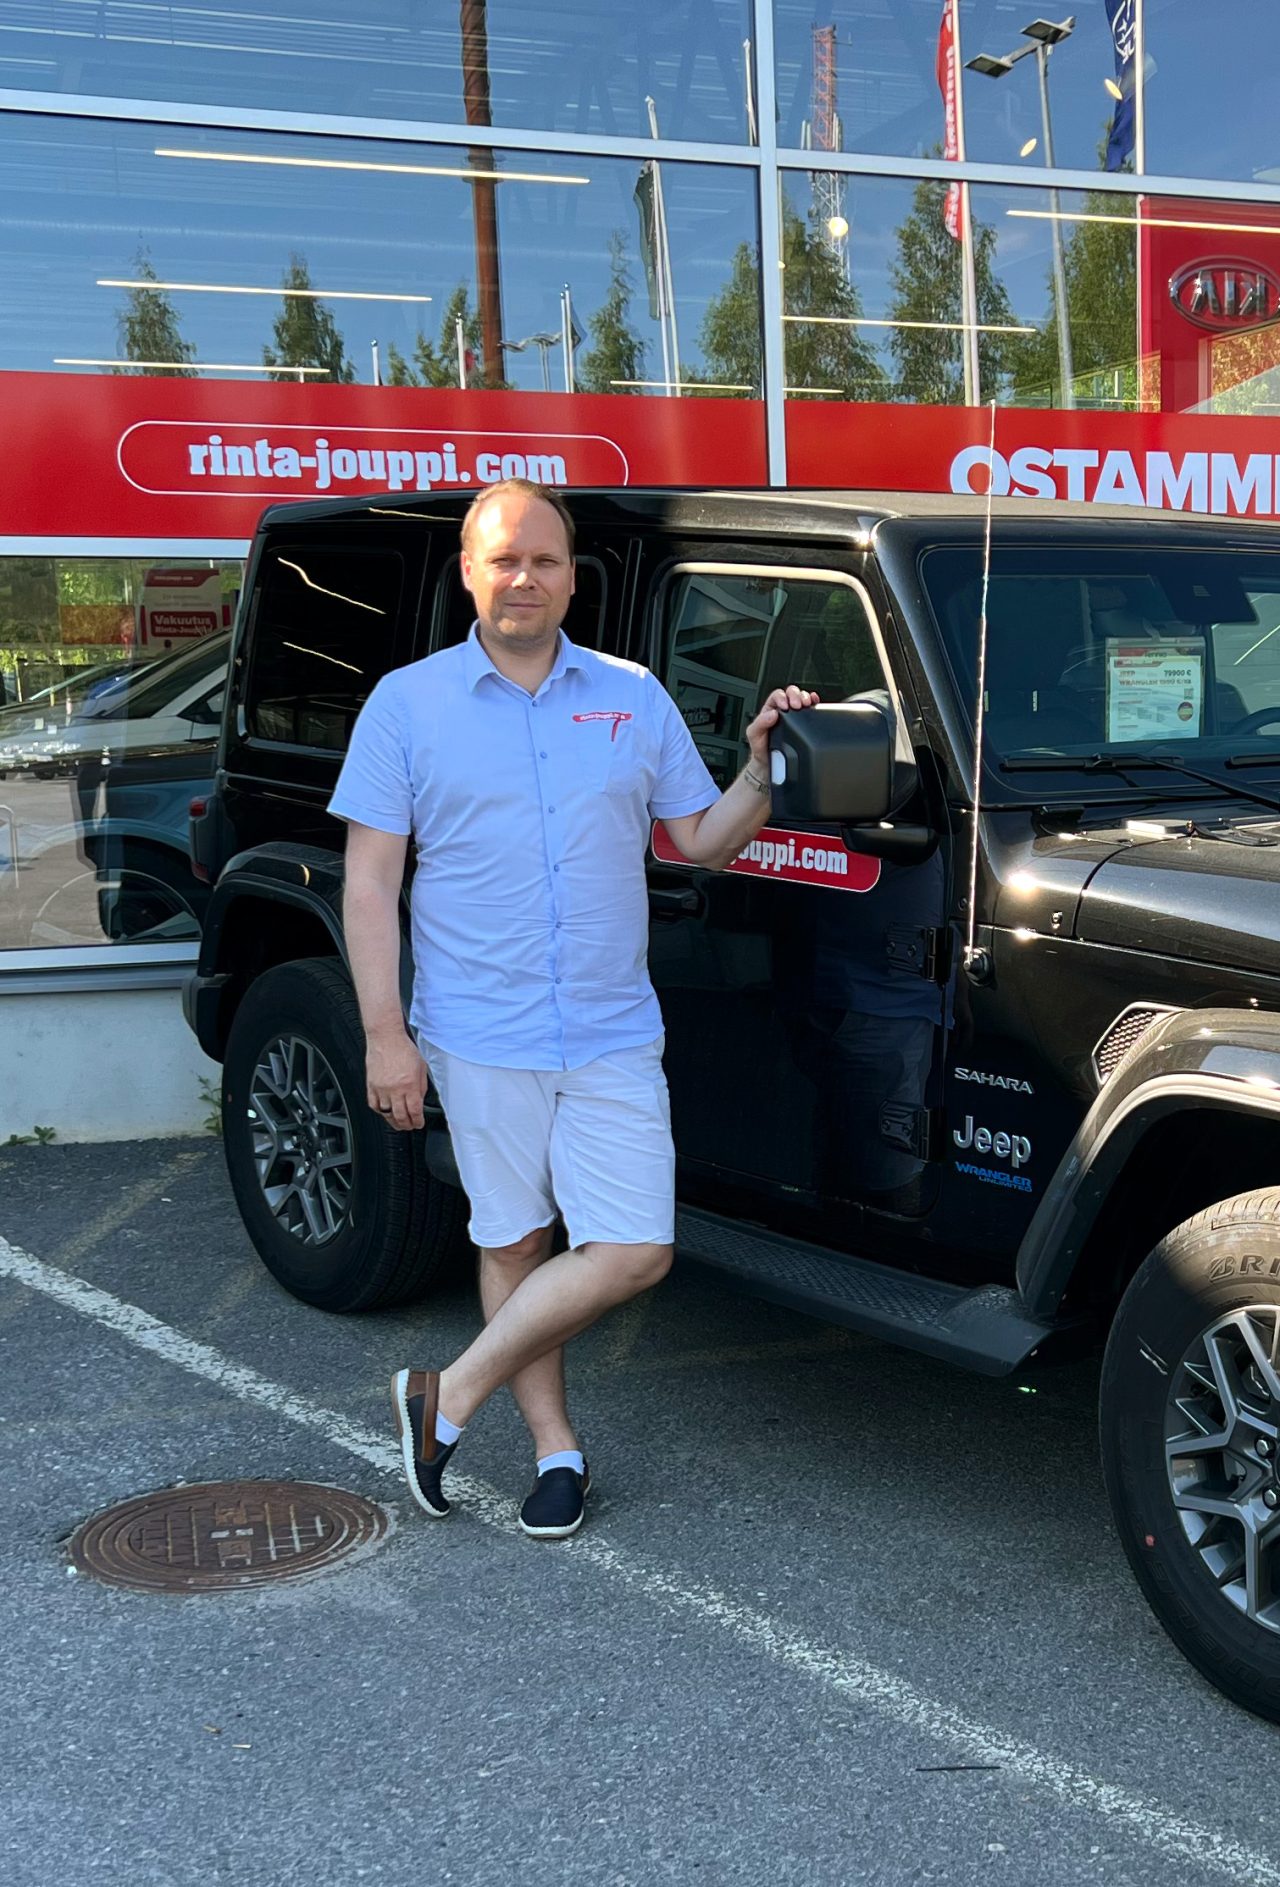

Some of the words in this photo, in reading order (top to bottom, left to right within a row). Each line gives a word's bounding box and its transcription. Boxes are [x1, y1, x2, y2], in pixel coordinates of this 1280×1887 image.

[188, 435, 568, 490] rinta-jouppi.com
[154, 615, 212, 626] Vakuutus
[730, 838, 849, 876] ouppi.com
[954, 1067, 1033, 1094] SAHARA
[953, 1115, 1031, 1168] Jeep
[955, 1161, 1032, 1187] WRANGLER
